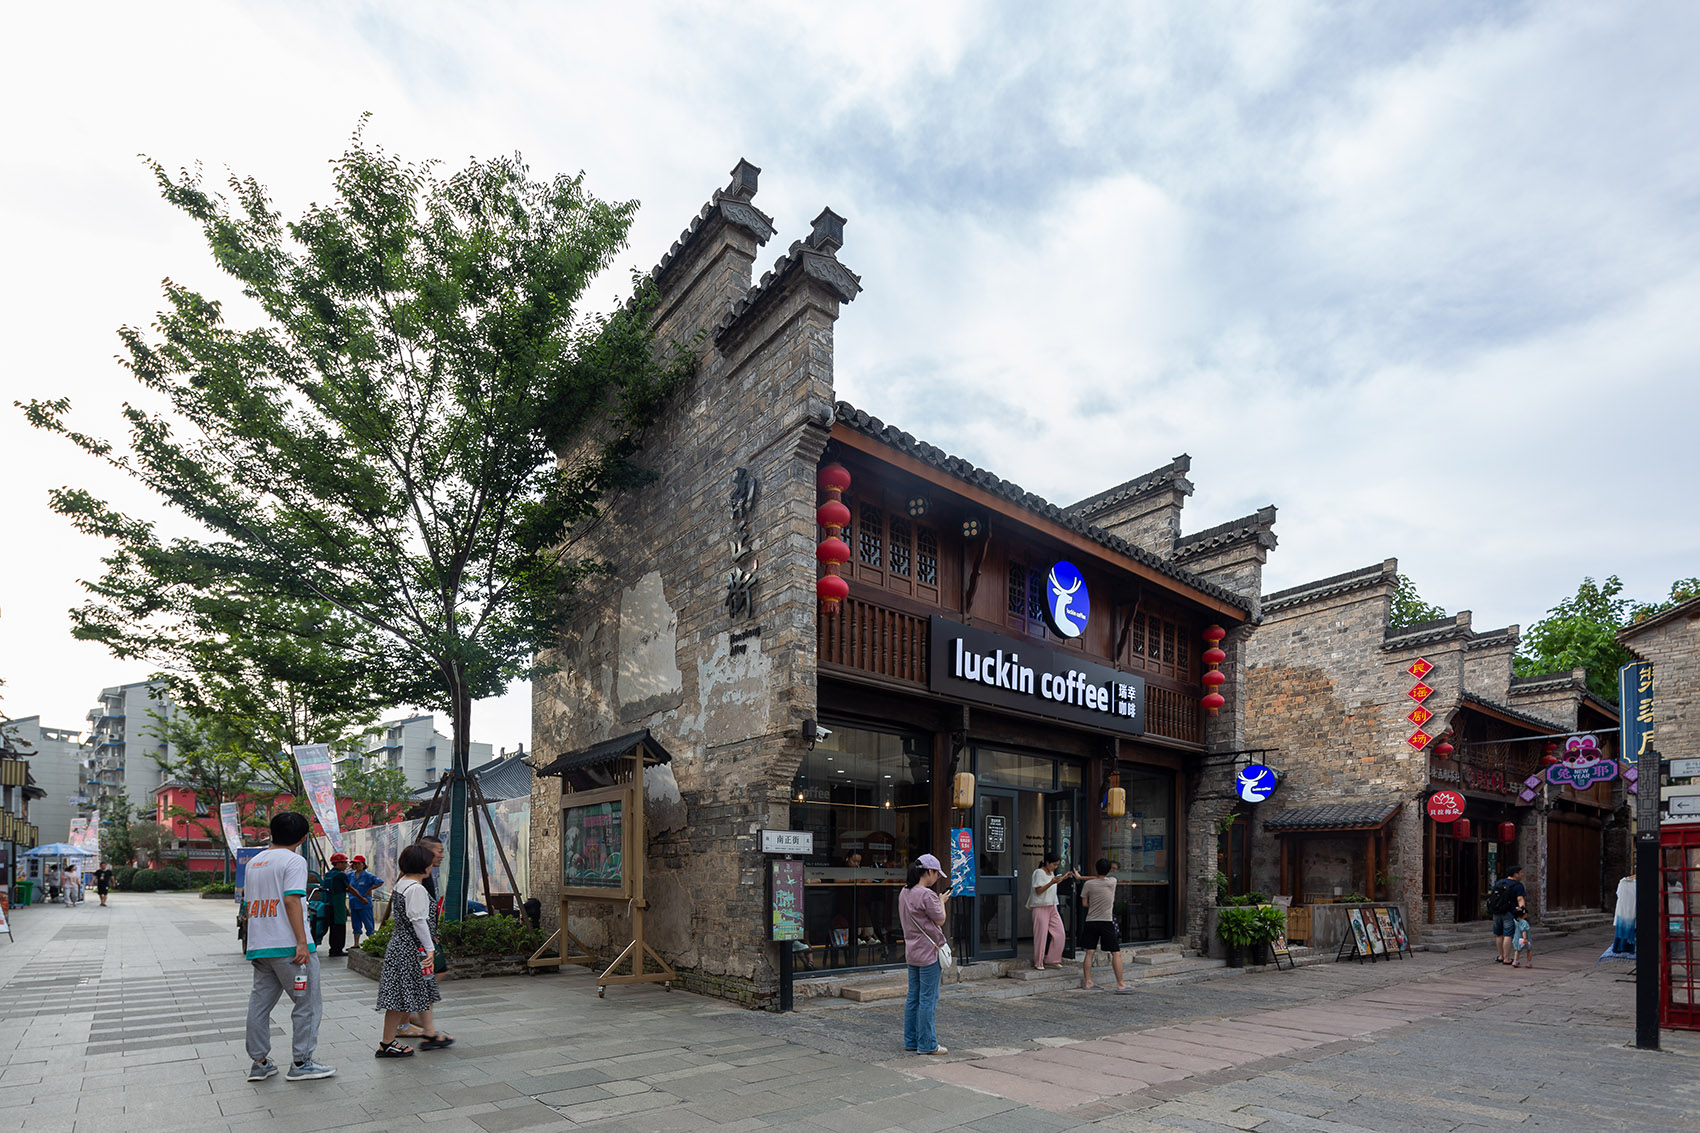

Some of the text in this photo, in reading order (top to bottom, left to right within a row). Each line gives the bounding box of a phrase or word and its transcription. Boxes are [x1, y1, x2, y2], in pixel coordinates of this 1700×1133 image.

[955, 638, 1109, 712] luckin coffee
[1118, 683, 1136, 701] 瑞幸
[1118, 701, 1136, 718] 咖啡
[776, 834, 800, 845] 南正街
